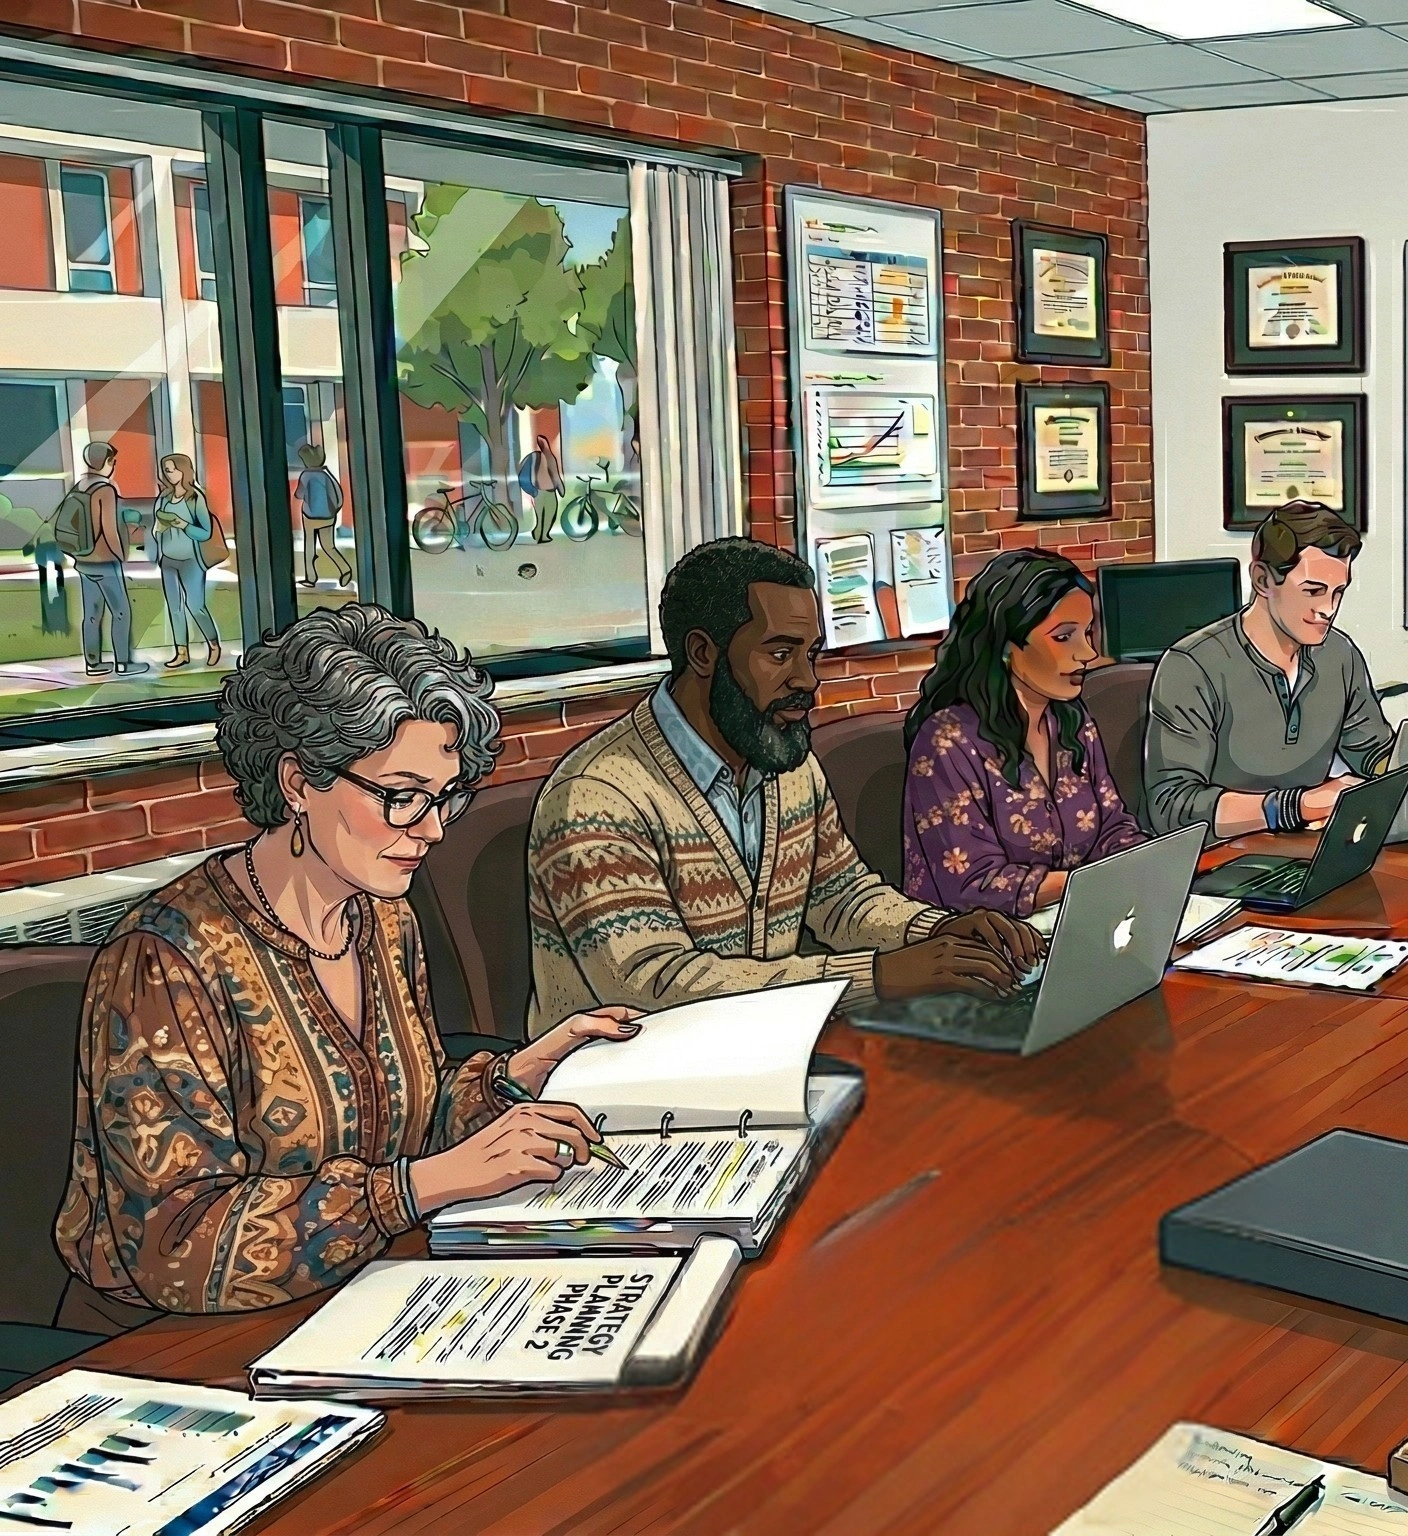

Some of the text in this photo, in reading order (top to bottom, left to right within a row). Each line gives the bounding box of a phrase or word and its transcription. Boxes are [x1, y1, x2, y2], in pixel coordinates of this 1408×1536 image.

[524, 1283, 589, 1351] PHASE 2
[582, 1273, 654, 1356] STRATEGY
